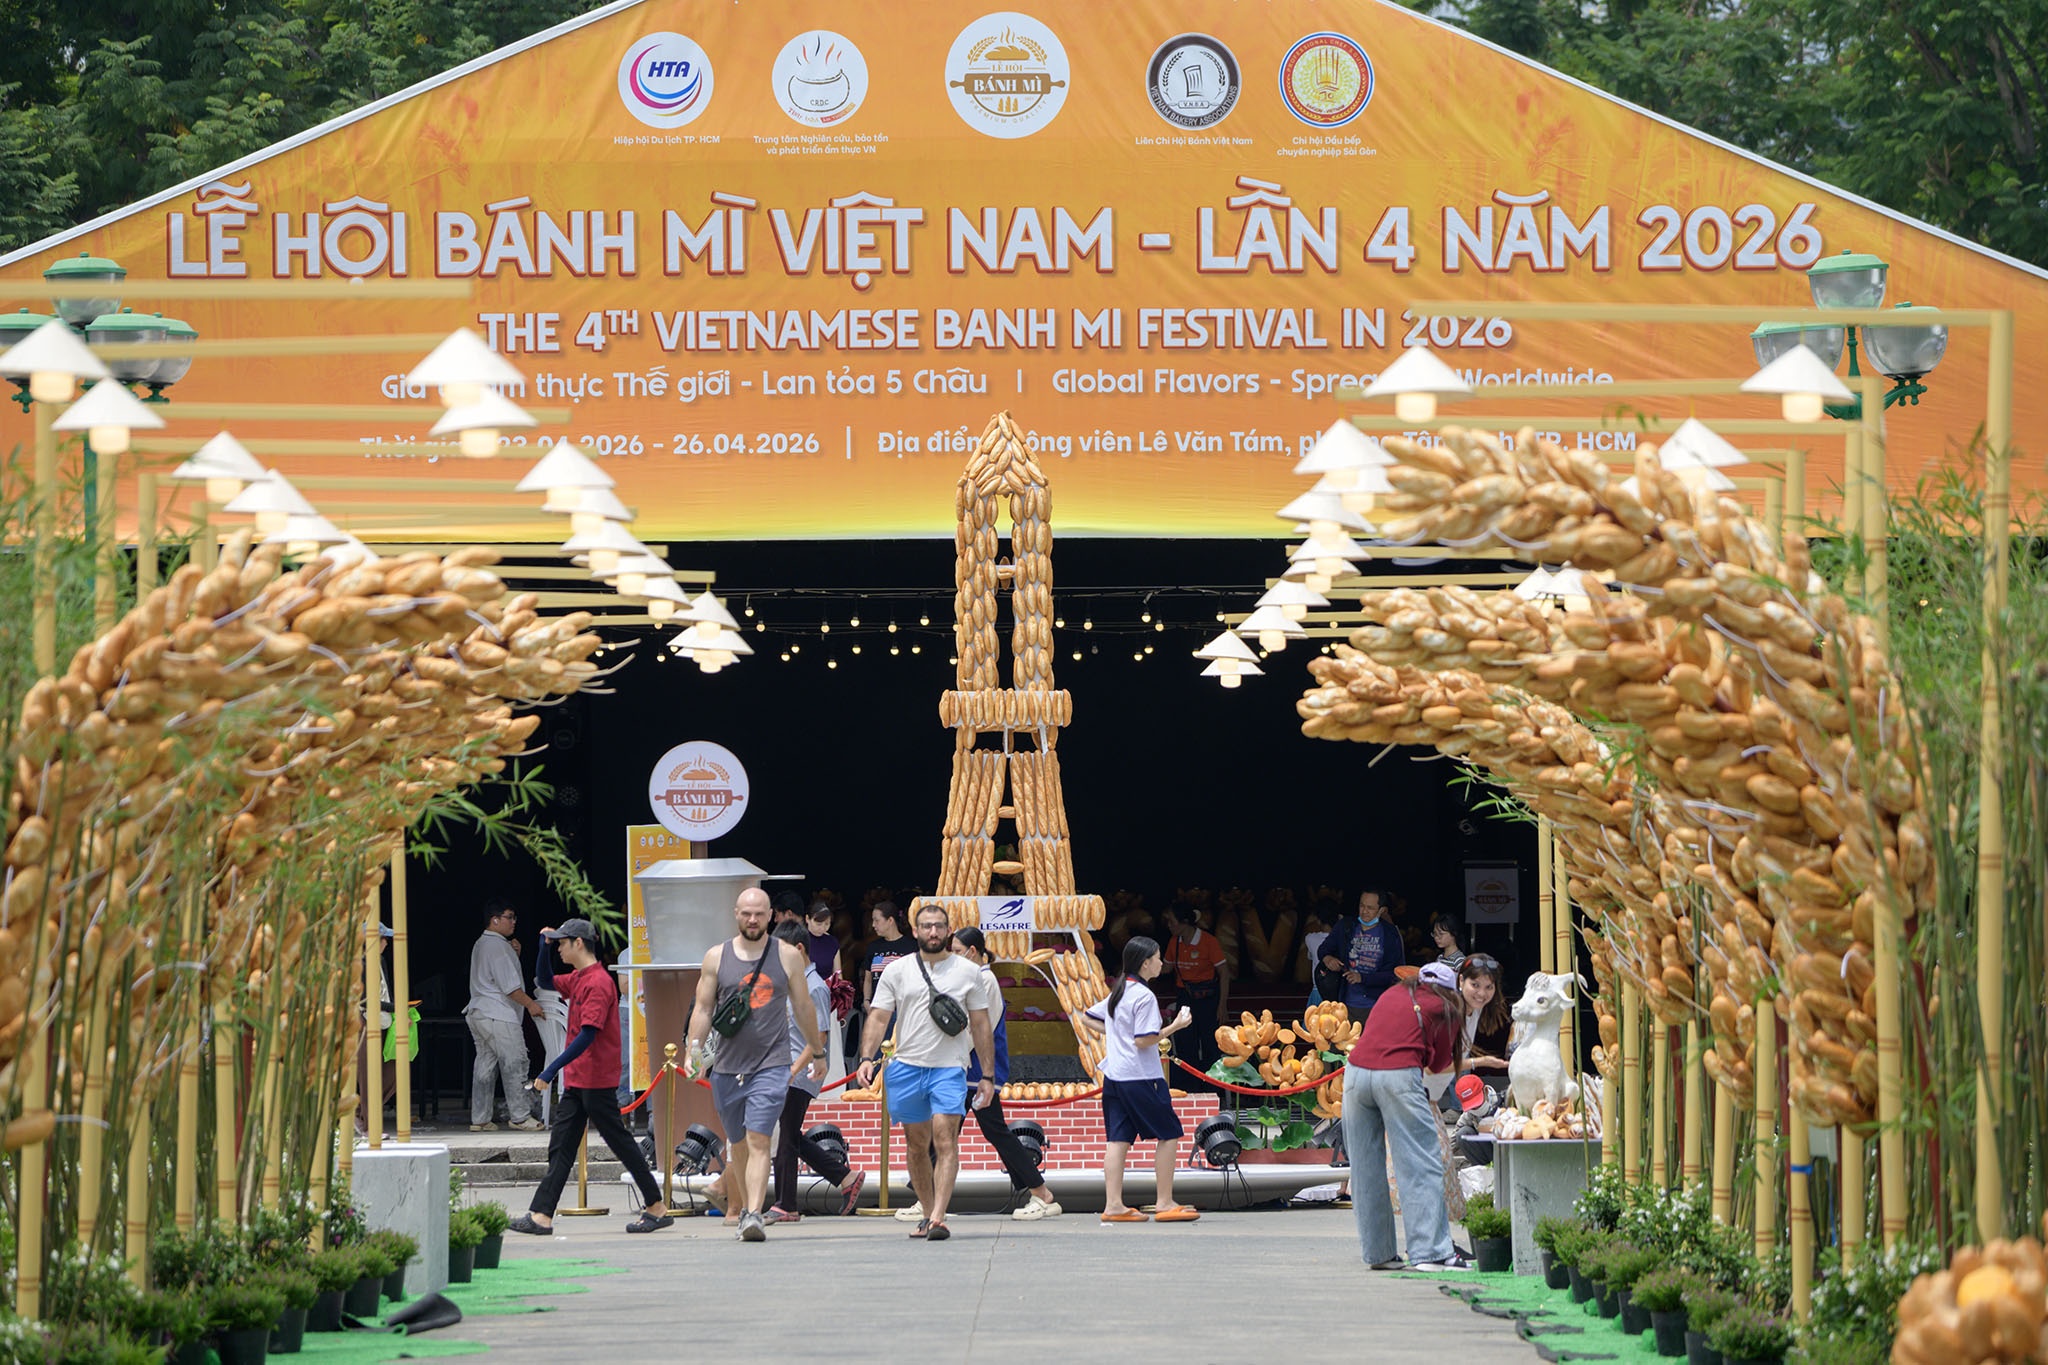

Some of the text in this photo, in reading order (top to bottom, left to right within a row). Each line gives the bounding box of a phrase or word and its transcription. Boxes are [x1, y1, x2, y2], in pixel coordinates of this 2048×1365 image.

[648, 61, 690, 78] HTA
[973, 75, 1042, 93] BÁNH MÌ
[810, 99, 829, 107] CRDC
[1150, 84, 1172, 118] VIETNAM
[1170, 112, 1198, 126] BAKERY
[613, 135, 720, 146] Hiệp hội Du lịch TP. HCM
[753, 135, 778, 145] Trung
[780, 134, 798, 143] tâm
[800, 135, 832, 145] Nghiên
[1135, 136, 1154, 145] Liên
[1155, 136, 1170, 145] Chi
[1188, 136, 1211, 145] Bánh
[1212, 136, 1230, 147] Việt
[1232, 136, 1253, 145] Nam
[766, 145, 777, 154] và
[778, 145, 800, 156] phát
[801, 144, 822, 154] triển
[841, 145, 861, 156] thực
[862, 145, 876, 153] VN
[1277, 146, 1310, 157] chuyên
[1311, 146, 1342, 158] nghiệp
[167, 180, 259, 278] LỄ
[273, 195, 407, 287] HỘI
[435, 196, 638, 278] BÁNH
[663, 190, 757, 276] MÌ
[768, 190, 925, 291] VIỆT
[947, 206, 1115, 274] NAM
[1197, 175, 1338, 274] LẦN
[1364, 206, 1415, 272] 4
[1443, 189, 1611, 274] NĂM
[1637, 202, 1824, 273] 2026
[478, 307, 1513, 352] THE 4TH VIETNAMESE BANH MI FESTIVAL IN 2026
[381, 373, 426, 399] Gia
[536, 372, 604, 403] thực
[612, 365, 670, 398] Thế
[677, 367, 732, 404] giới
[763, 370, 816, 395] Lan
[826, 365, 876, 395] tỏa
[886, 370, 903, 394] 5
[913, 366, 987, 395] Châu
[1052, 368, 1144, 394] Global
[1154, 368, 1261, 394] Flavors
[1290, 368, 1378, 400] Sprea
[673, 432, 820, 455] 26.04.2026
[877, 430, 920, 458] Địa
[1024, 430, 1072, 457] ông
[1079, 429, 1132, 452] viên
[1139, 428, 1168, 452] Lê
[1174, 430, 1224, 452] Văn
[1229, 430, 1292, 456] Tám,
[1577, 431, 1637, 451] HCM
[672, 791, 726, 804] BÁNH MÌ
[632, 914, 647, 928] BÁN
[980, 922, 1032, 931] LESAFFRE
